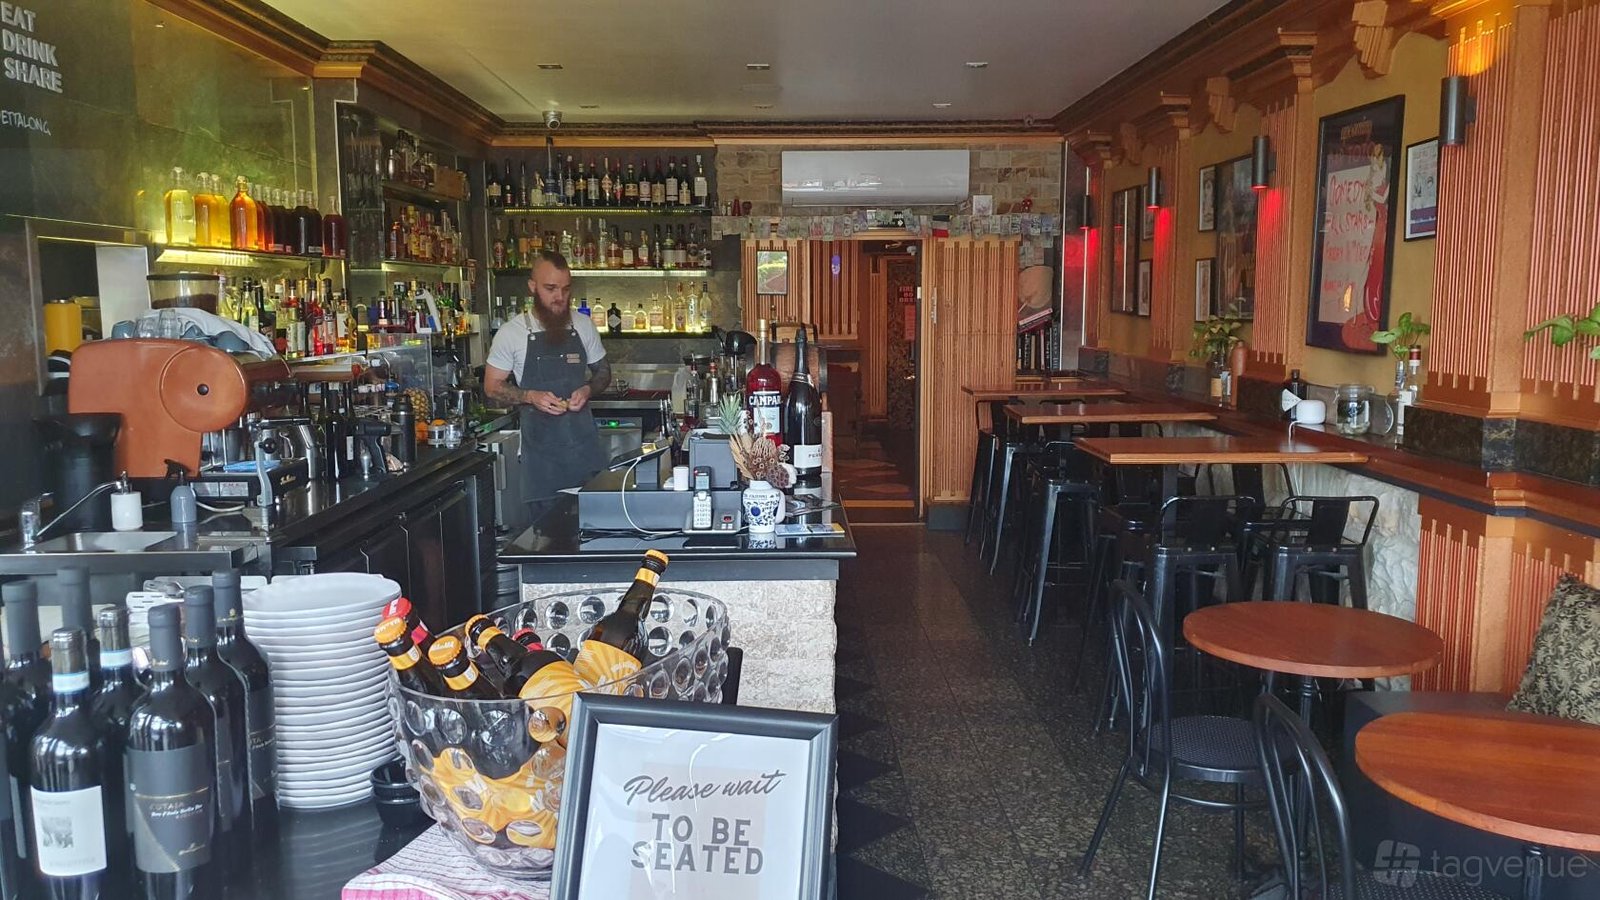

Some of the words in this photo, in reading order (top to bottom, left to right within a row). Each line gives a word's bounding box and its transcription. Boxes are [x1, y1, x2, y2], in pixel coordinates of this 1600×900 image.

[0, 1, 36, 32] EAT
[2, 28, 59, 67] DRINK
[4, 57, 63, 94] SHARE
[623, 775, 721, 806] Please
[722, 769, 787, 797] wait
[651, 813, 693, 842] TO
[711, 817, 751, 847] BE
[631, 840, 764, 875] SEATED
